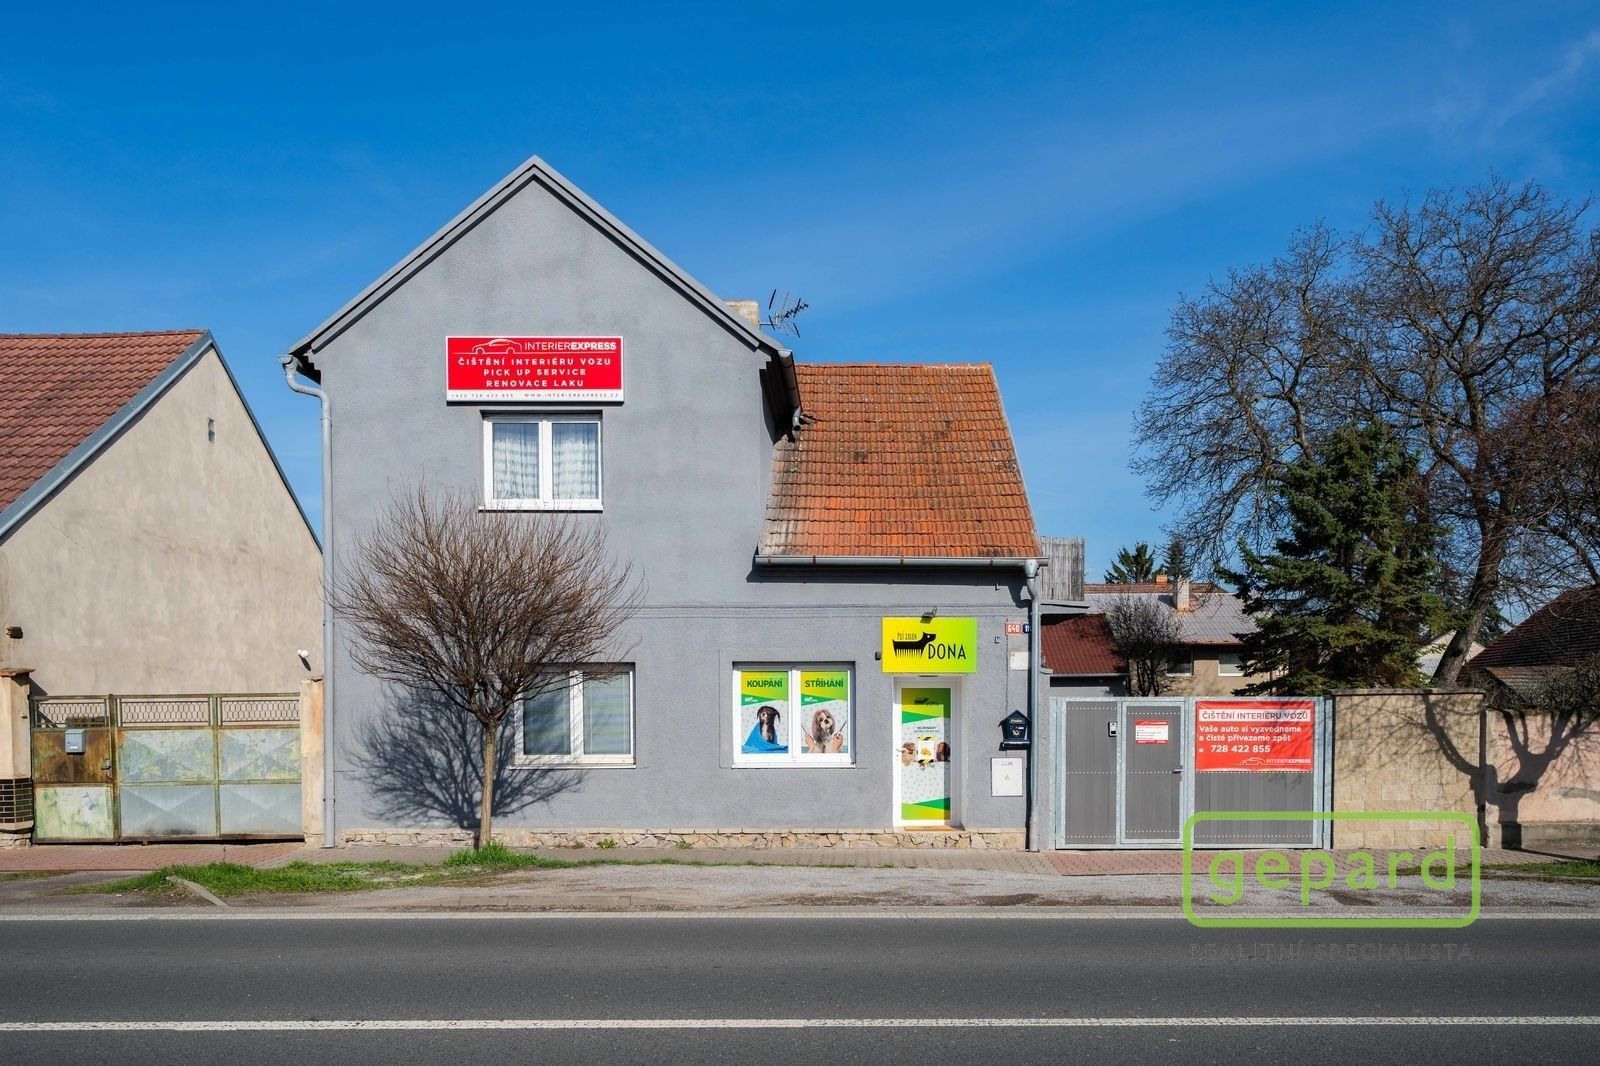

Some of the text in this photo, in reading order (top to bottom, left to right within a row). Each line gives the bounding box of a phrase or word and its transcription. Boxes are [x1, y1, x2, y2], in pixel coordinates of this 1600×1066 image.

[524, 341, 617, 351] INTERIEREXPRESS
[457, 357, 611, 366] ČIŠTĚNÍ INTERIÉRU VOZU
[486, 380, 548, 388] RENOVACE
[1007, 624, 1020, 633] 640
[928, 643, 967, 660] DONA
[746, 677, 783, 688] KOUPÁNÍ
[805, 677, 844, 688] STŘÍHÁNÍ
[1201, 710, 1236, 720] ČIŠTĚNÍ
[1238, 710, 1282, 720] INTERIÉRU
[1199, 725, 1302, 734] Vaše auto si vyzvedneme
[1206, 734, 1226, 742] čisté
[1227, 734, 1270, 743] přivezeme
[1272, 734, 1292, 743] zpět
[1210, 745, 1271, 753] 728 422 855
